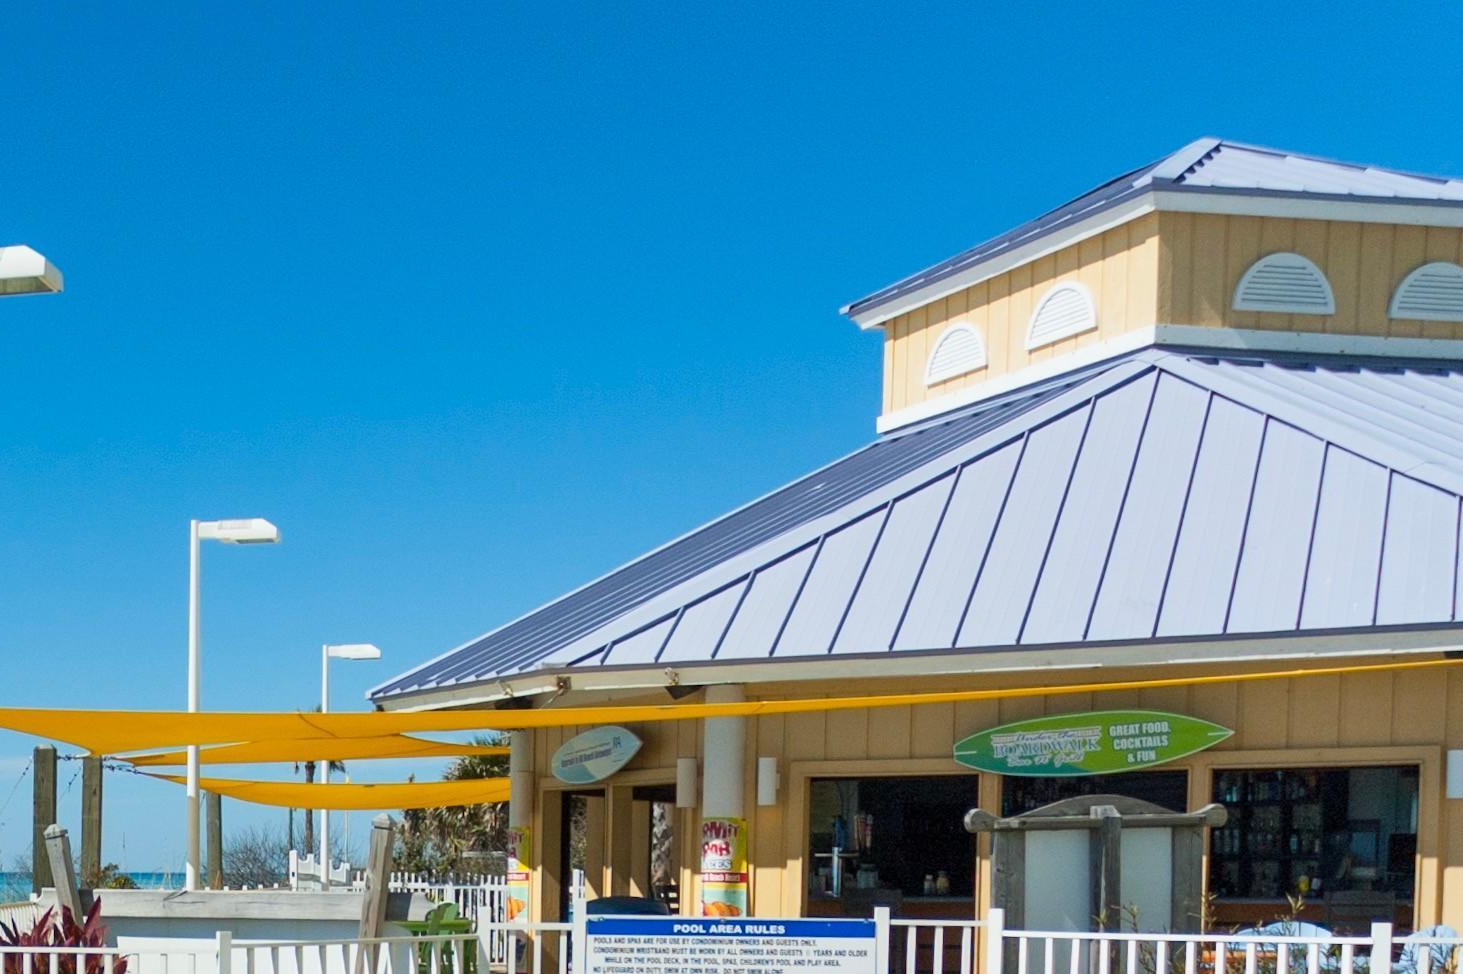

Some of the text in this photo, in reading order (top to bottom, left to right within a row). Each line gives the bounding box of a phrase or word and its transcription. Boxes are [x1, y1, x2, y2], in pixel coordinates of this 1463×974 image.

[1110, 724, 1140, 736] GREAT
[1114, 736, 1168, 750] COCKTAILS
[1128, 750, 1155, 762] & FUN
[673, 924, 786, 934] POOL AREA RULES
